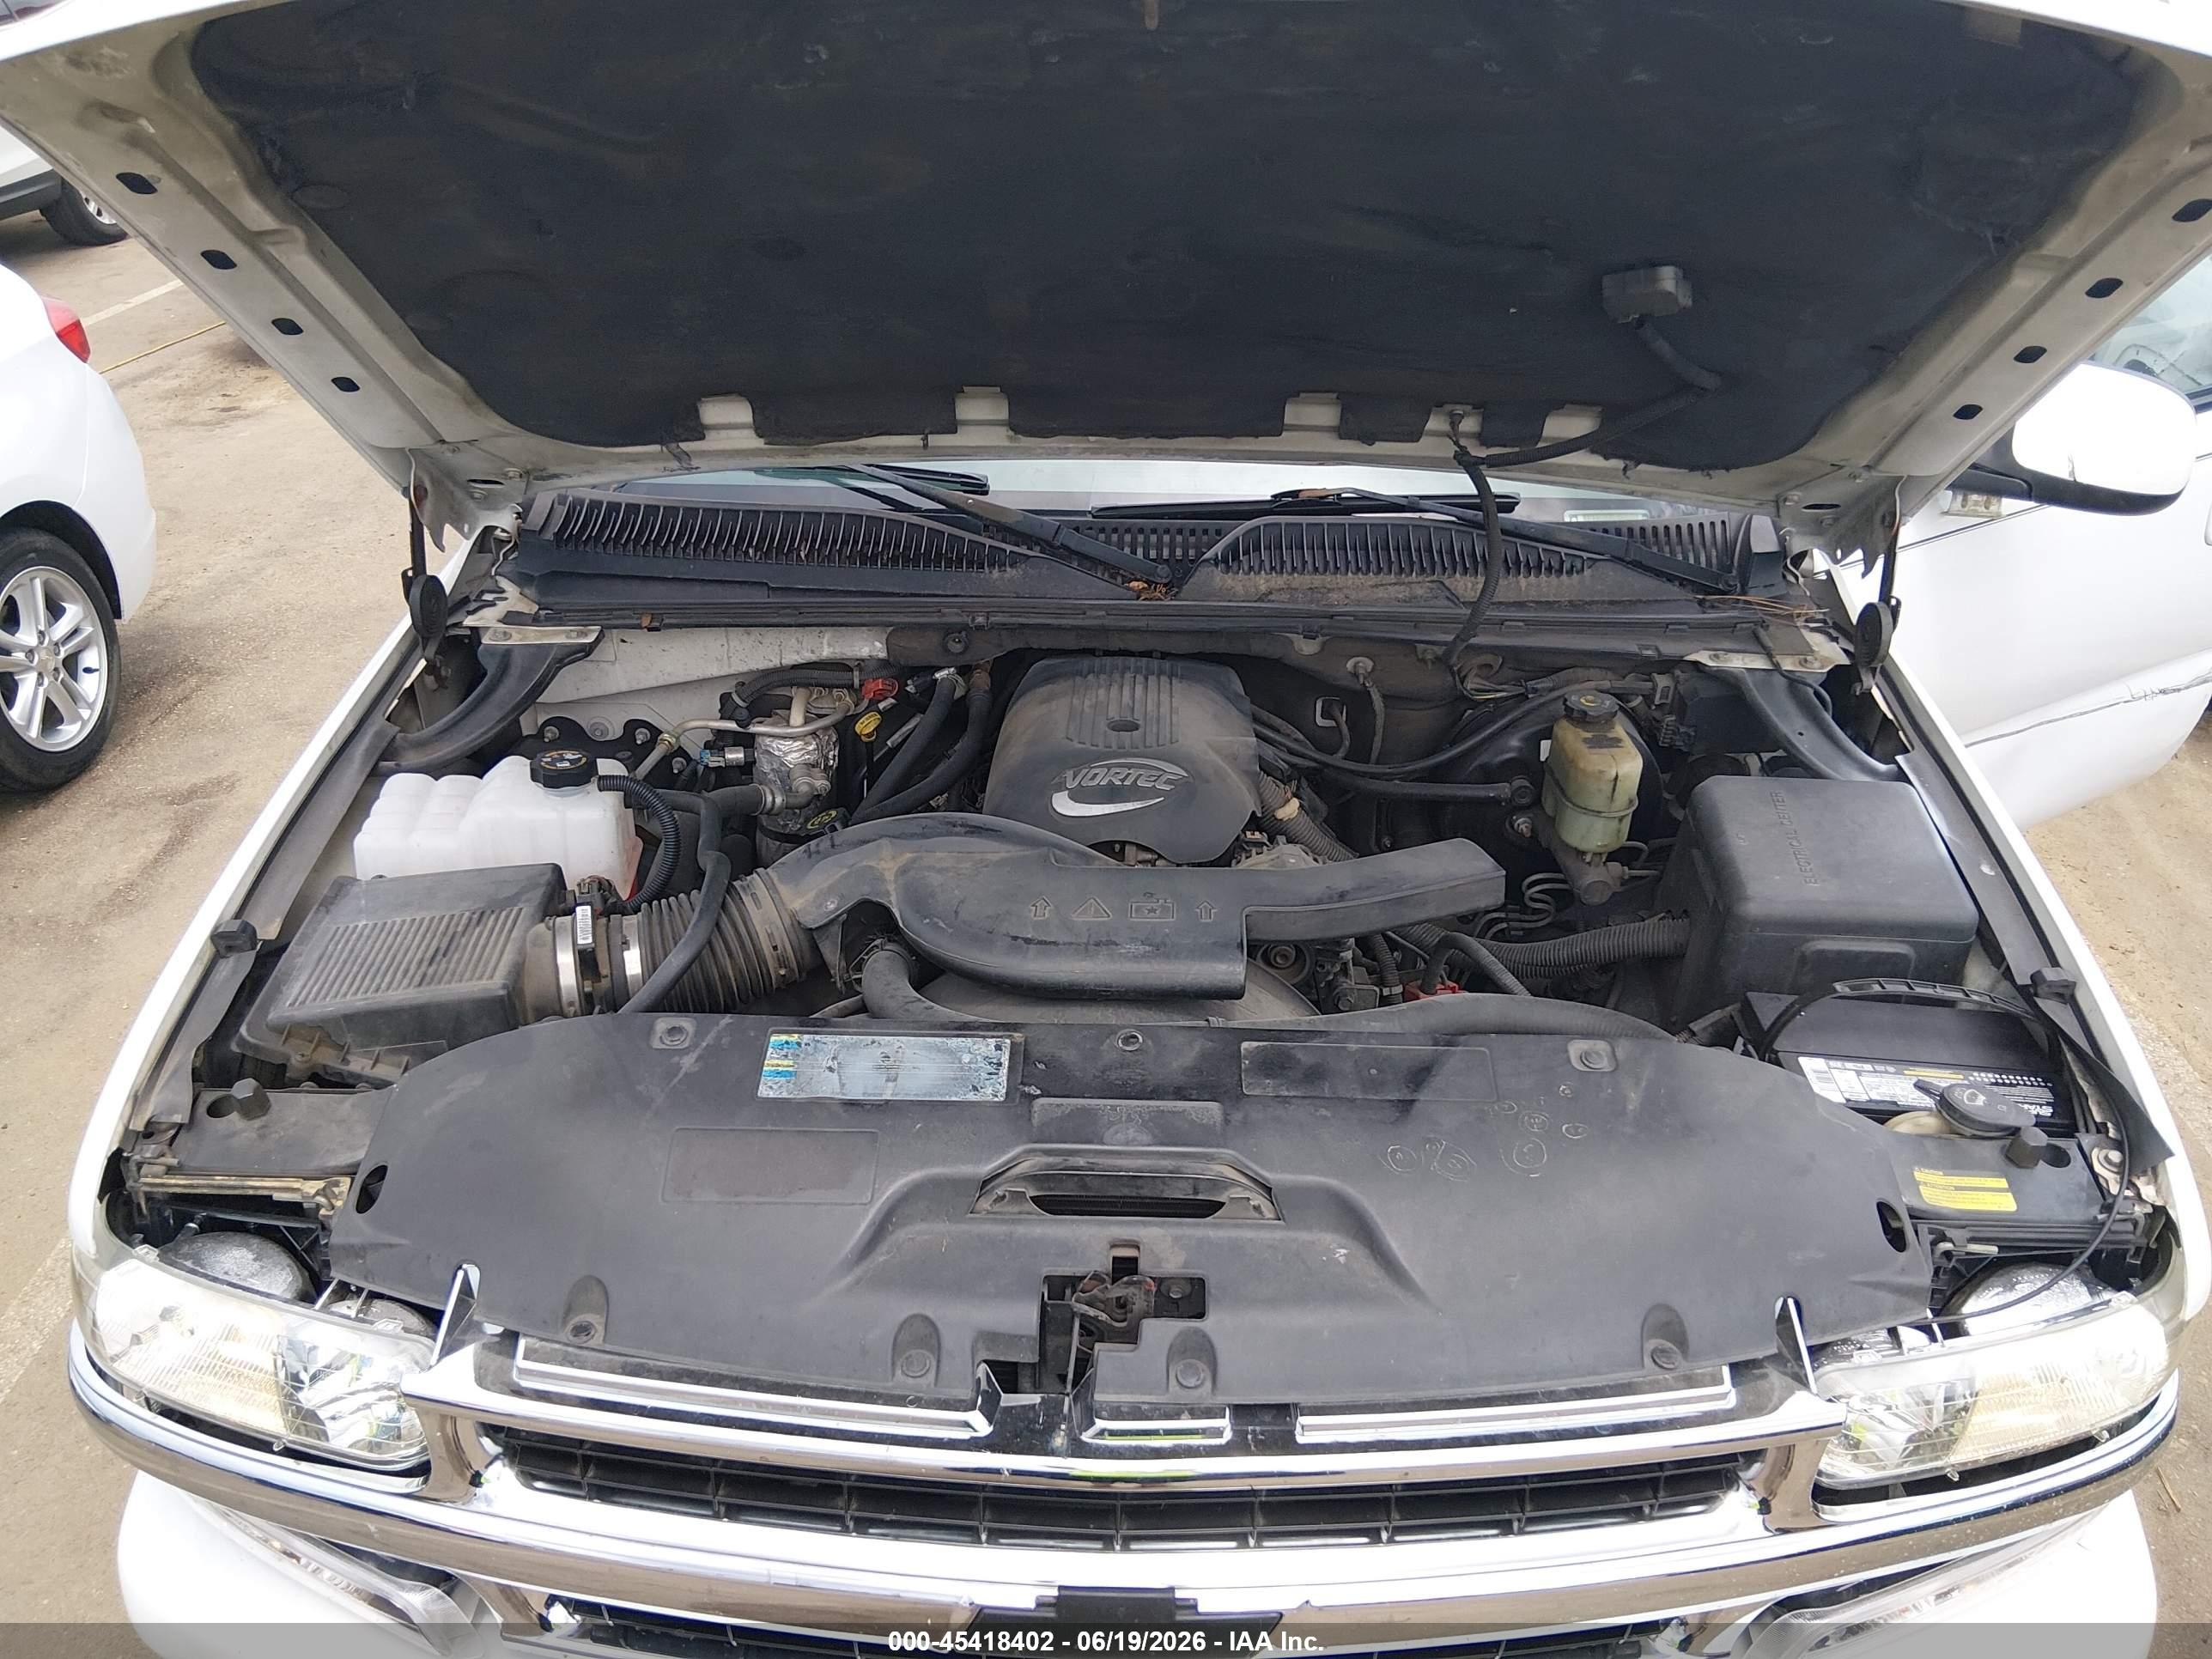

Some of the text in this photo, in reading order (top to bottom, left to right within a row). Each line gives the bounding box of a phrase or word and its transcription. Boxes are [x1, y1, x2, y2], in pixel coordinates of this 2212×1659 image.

[1064, 768, 1183, 790] VORTEC
[1771, 791, 1820, 886] ELECTRICAL CENTER
